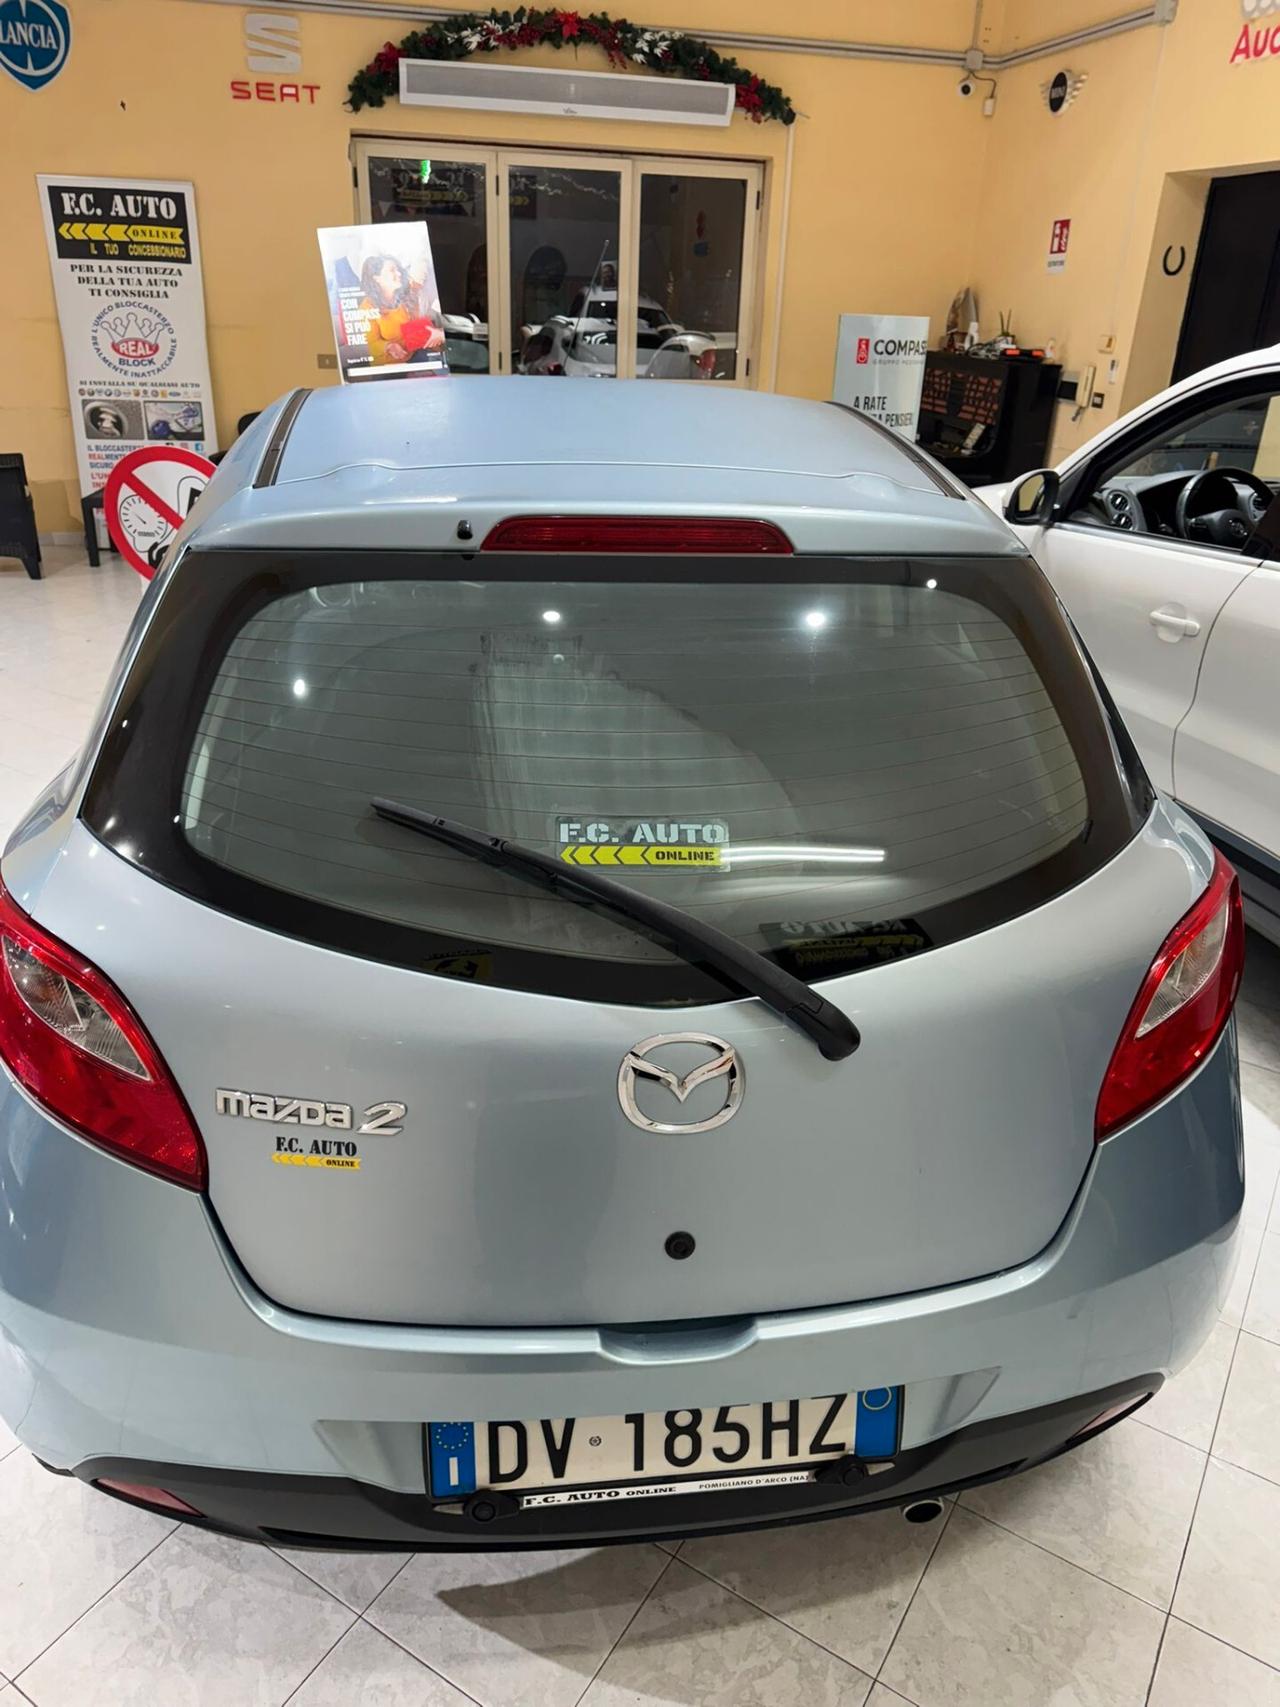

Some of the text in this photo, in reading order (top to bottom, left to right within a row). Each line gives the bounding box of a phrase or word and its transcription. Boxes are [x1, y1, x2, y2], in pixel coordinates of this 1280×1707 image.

[0, 20, 58, 50] LANCIA
[230, 80, 321, 104] SEAT
[61, 192, 177, 220] F.C. AUTO
[132, 229, 178, 240] ONLINE
[89, 242, 186, 259] IL TUO CONCESSIONARIO
[70, 264, 183, 277] PER LA SICUREZZA
[77, 277, 178, 288] DELLA TUA AUTO
[88, 288, 169, 299] TI CONSIGLIA
[115, 301, 174, 335] BLOCCASTERZO
[91, 335, 129, 376] REALMENTE
[119, 340, 155, 356] REAL
[130, 338, 177, 378] INATTACCABILE
[118, 358, 156, 367] BLOCK
[853, 396, 887, 410] A RATE
[559, 823, 726, 844] F.C. AUTO
[655, 850, 715, 861] ONLINE
[356, 1101, 408, 1136] 2
[275, 1136, 358, 1157] F.C. AUTO
[326, 1159, 356, 1168] ONLINE
[487, 1418, 577, 1485] DV
[624, 1393, 849, 1472] 185HZ
[525, 1495, 561, 1506] F.C.
[567, 1490, 620, 1502] AUTO
[626, 1486, 677, 1497] ONLINE
[698, 1479, 753, 1490] POMIGLIANO
[755, 1476, 788, 1485] D'ARCO
